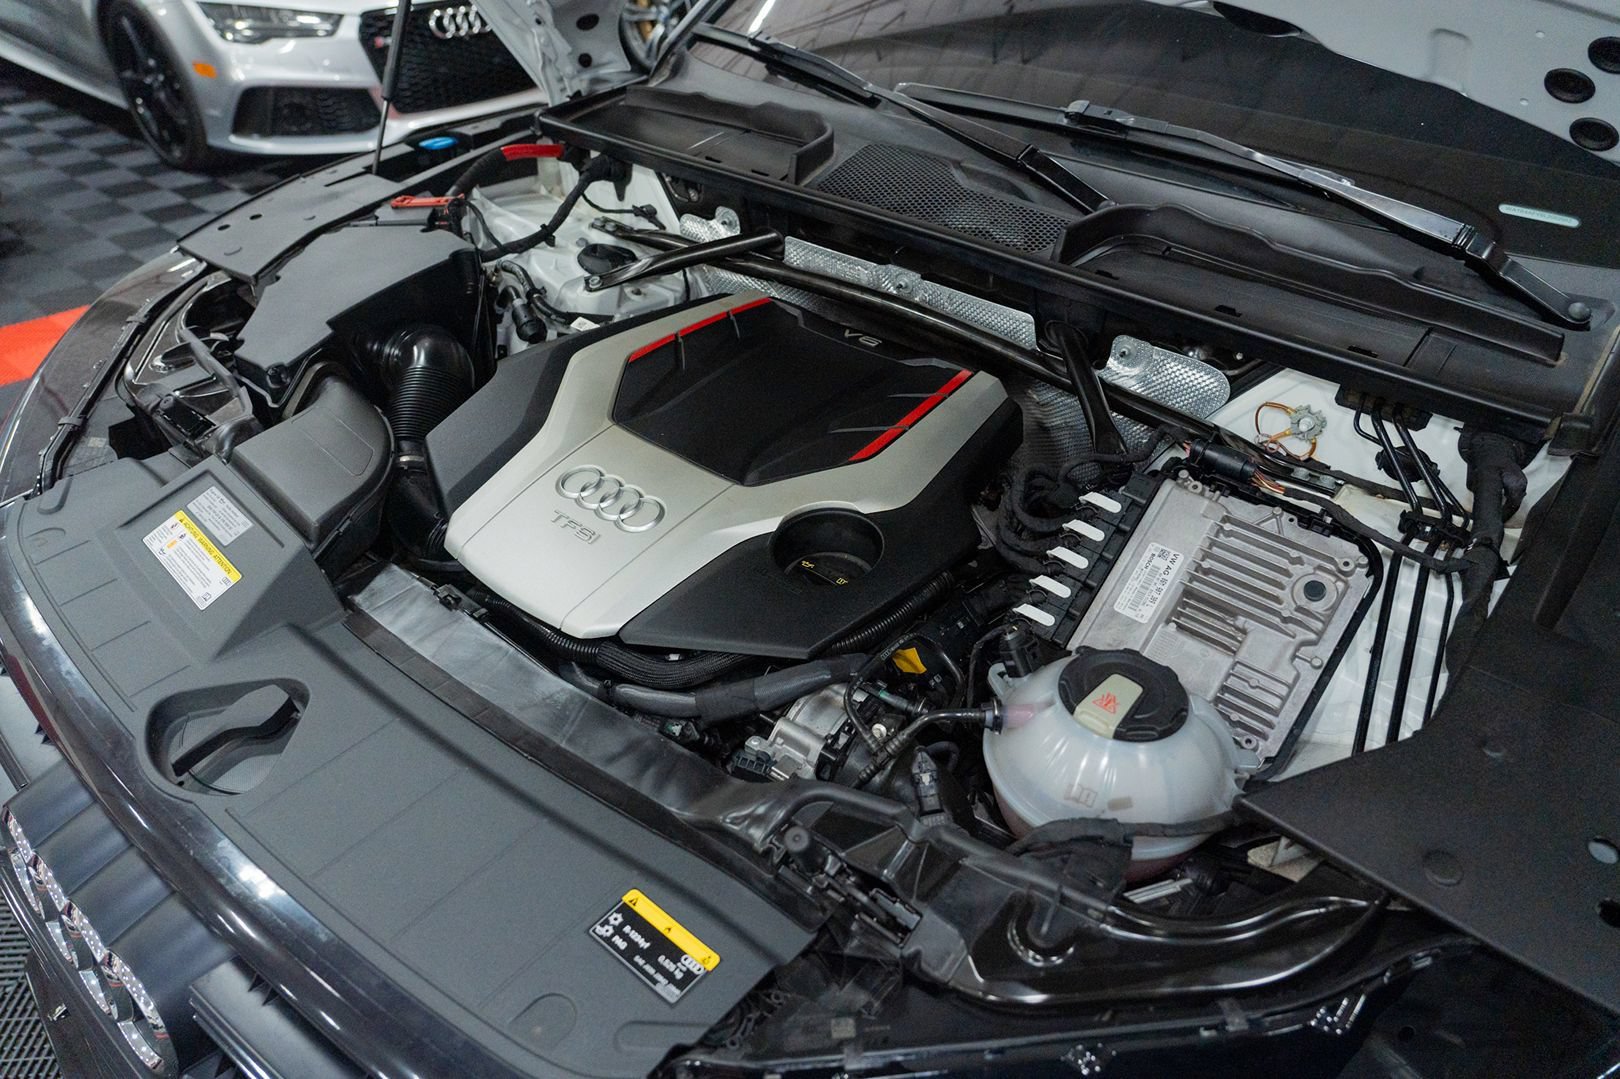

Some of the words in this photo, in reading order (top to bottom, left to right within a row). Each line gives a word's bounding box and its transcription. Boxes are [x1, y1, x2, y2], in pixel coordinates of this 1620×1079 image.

[844, 329, 882, 347] V6
[550, 509, 602, 545] TFSI
[213, 554, 232, 574] ATTENTION
[1168, 553, 1180, 565] VW
[1163, 565, 1173, 576] AG
